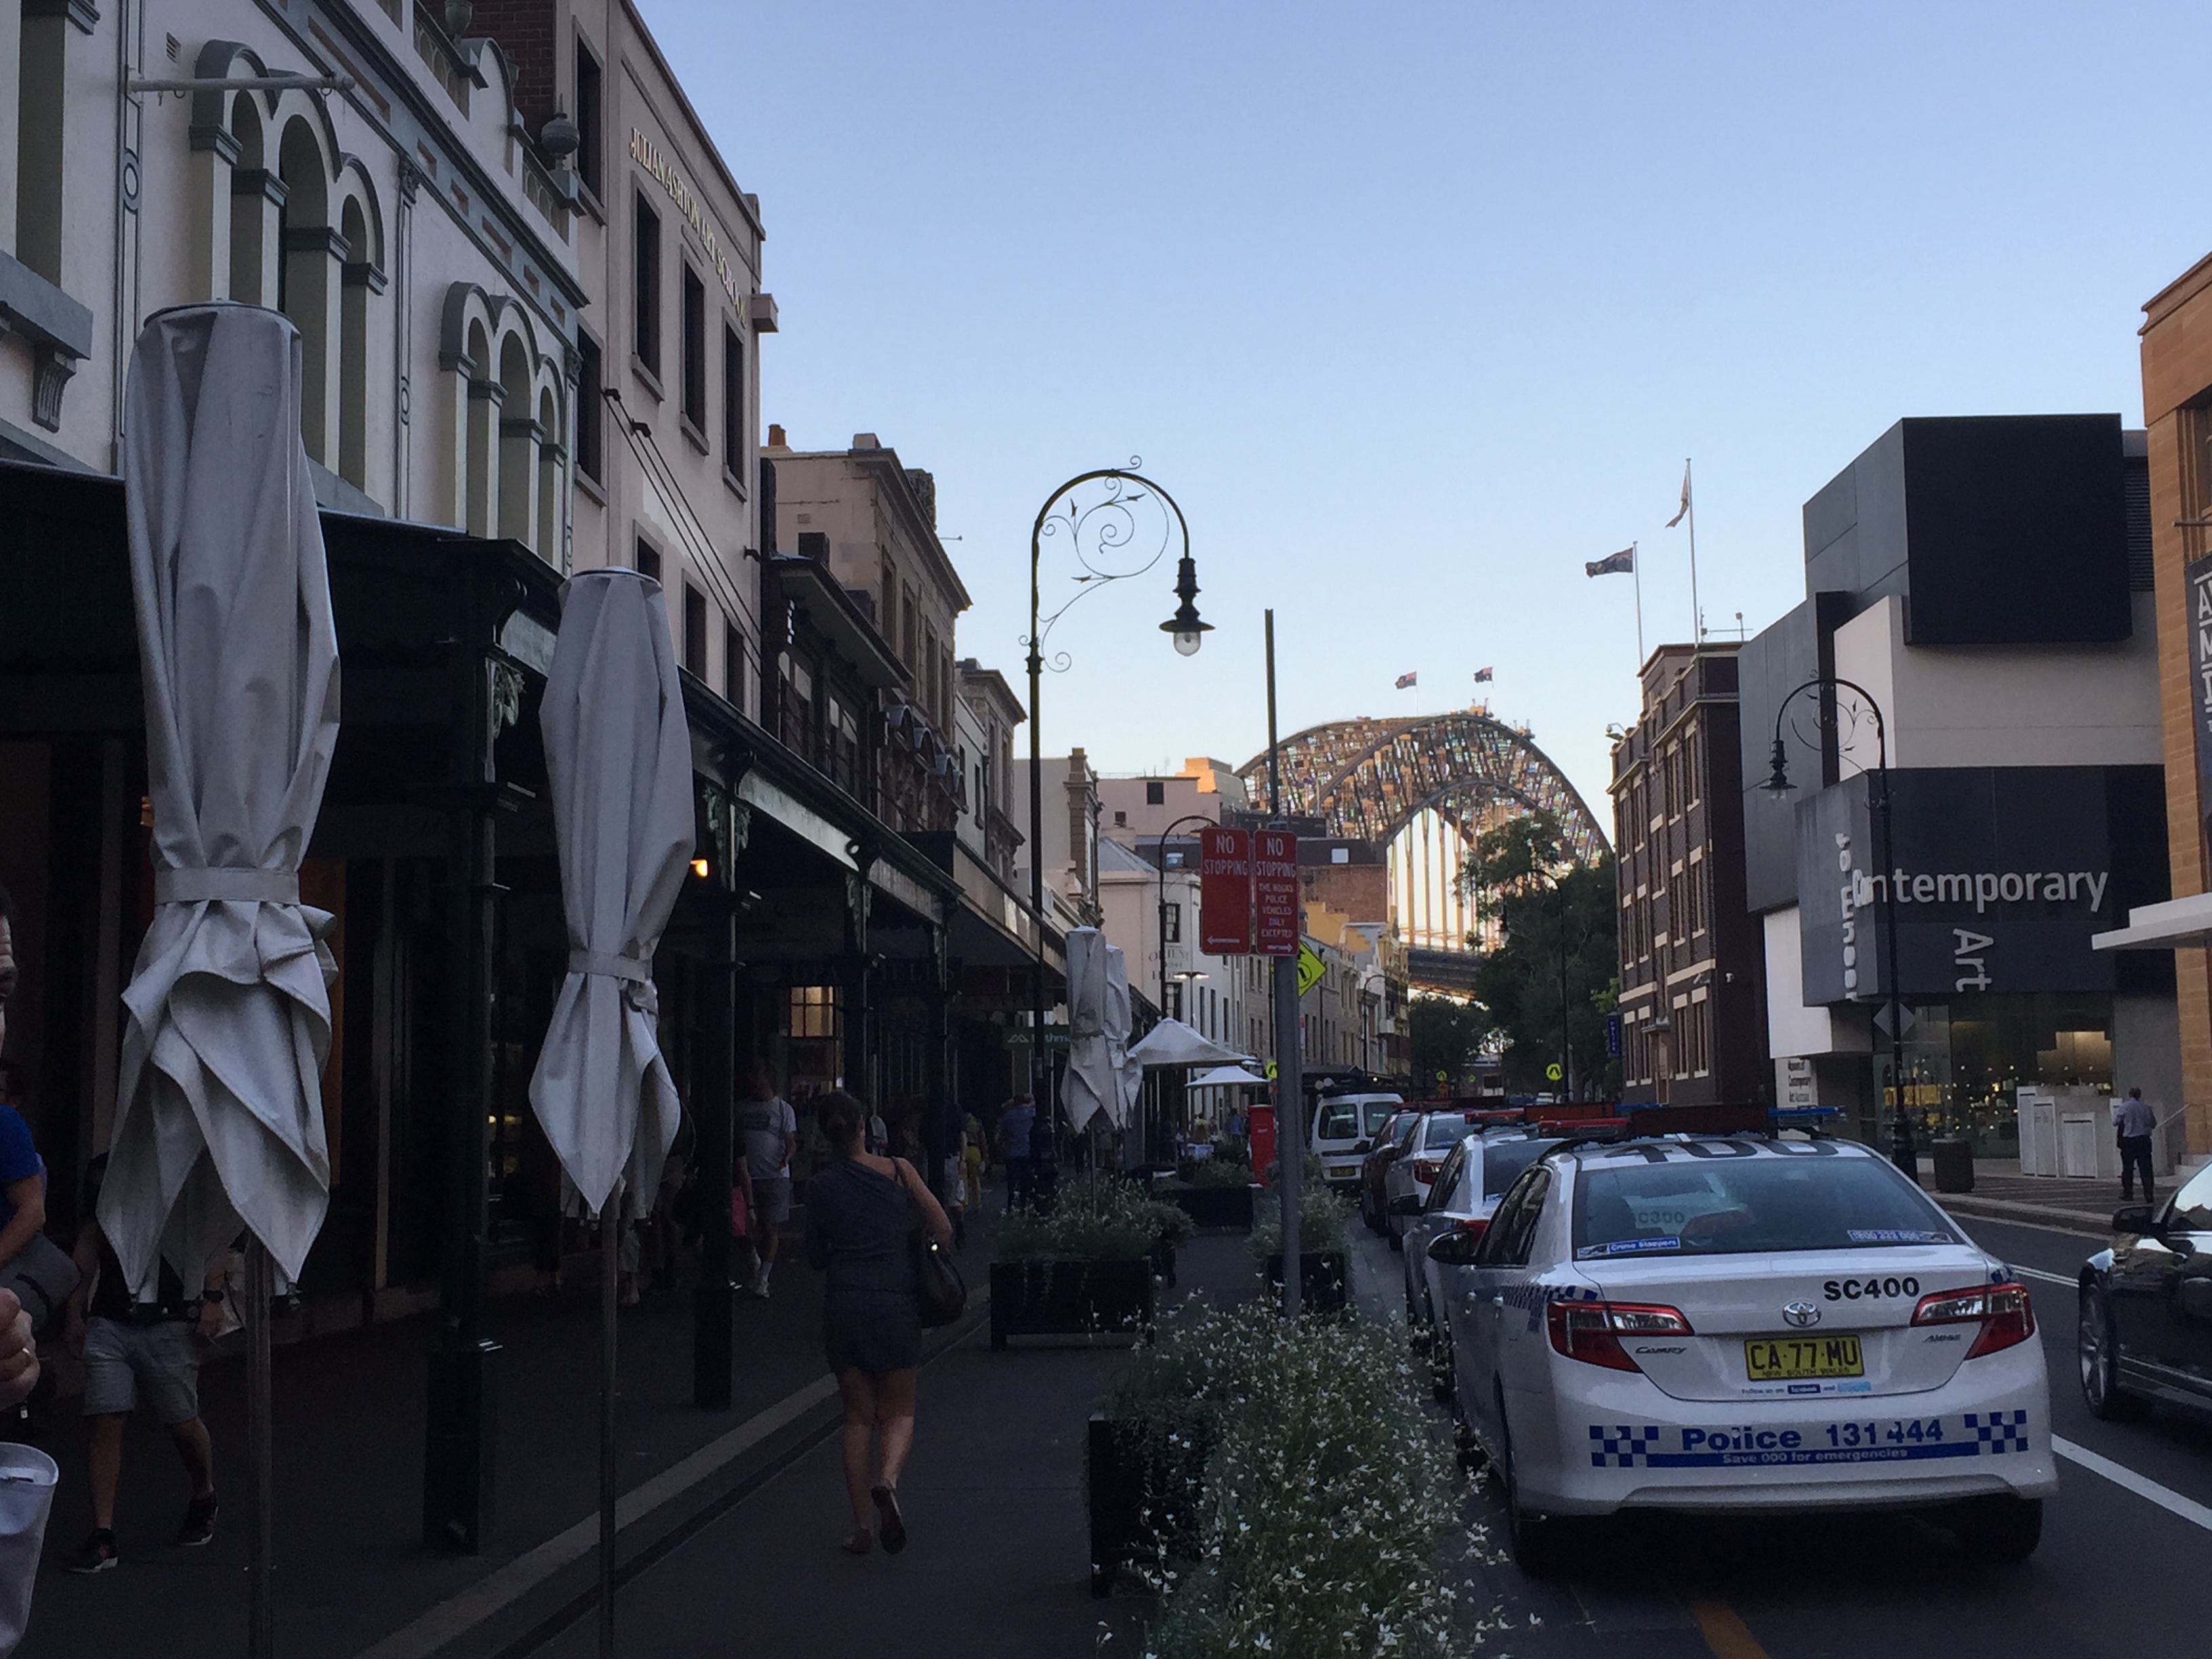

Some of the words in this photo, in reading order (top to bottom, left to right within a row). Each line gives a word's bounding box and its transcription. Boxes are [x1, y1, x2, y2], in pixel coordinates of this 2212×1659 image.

[630, 127, 665, 186] JULIAN
[665, 165, 699, 234] ASHTON
[699, 217, 716, 262] ART
[716, 247, 747, 329] SCHOOL
[1216, 835, 1234, 854] NO
[1267, 838, 1284, 857] NO
[1204, 859, 1248, 876] STOPPING
[1256, 861, 1296, 878] STOPPING
[1265, 895, 1288, 904] POLICE
[1852, 868, 2108, 914] Contemporary
[1952, 928, 1994, 992] Art
[1605, 1140, 1839, 1164] 400
[1611, 1241, 1636, 1252] Crime
[1639, 1237, 1678, 1250] Stoppers
[1824, 1276, 1921, 1302] SC400
[1786, 1368, 1817, 1376] SOUTH
[1820, 1366, 1851, 1375] WALES
[1681, 1426, 1802, 1452] Police
[1826, 1422, 1877, 1447] 131
[1887, 1418, 1944, 1444] 444
[1722, 1453, 1757, 1465] Save
[1761, 1452, 1787, 1463] 000
[1791, 1452, 1811, 1462] for
[1816, 1448, 1908, 1461] emergencies
